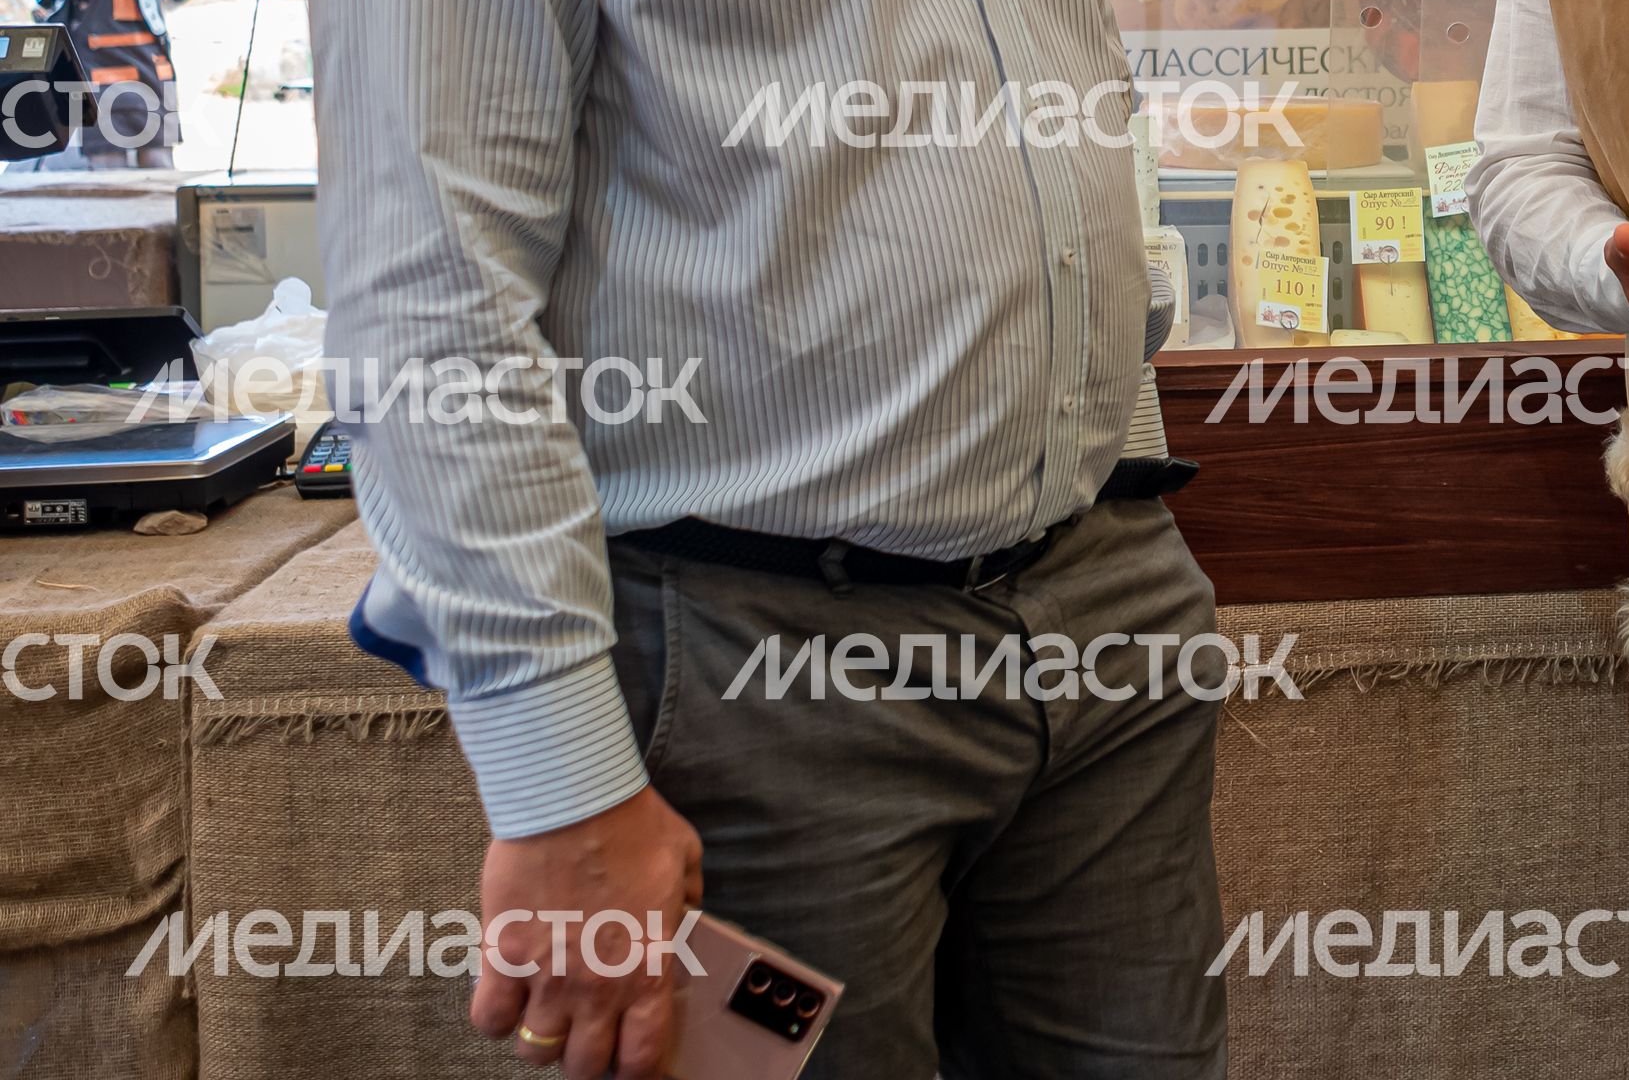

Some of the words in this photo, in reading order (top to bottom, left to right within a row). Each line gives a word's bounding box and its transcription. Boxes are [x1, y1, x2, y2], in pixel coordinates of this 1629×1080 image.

[1363, 191, 1377, 200] Сыр
[1379, 189, 1414, 200] Авторский
[1361, 200, 1387, 210] Опус
[1375, 215, 1395, 231] 90
[1265, 251, 1280, 261] Сыр
[1280, 253, 1316, 266] Авторский
[1262, 260, 1290, 273] Опус
[1275, 279, 1304, 296] 110
